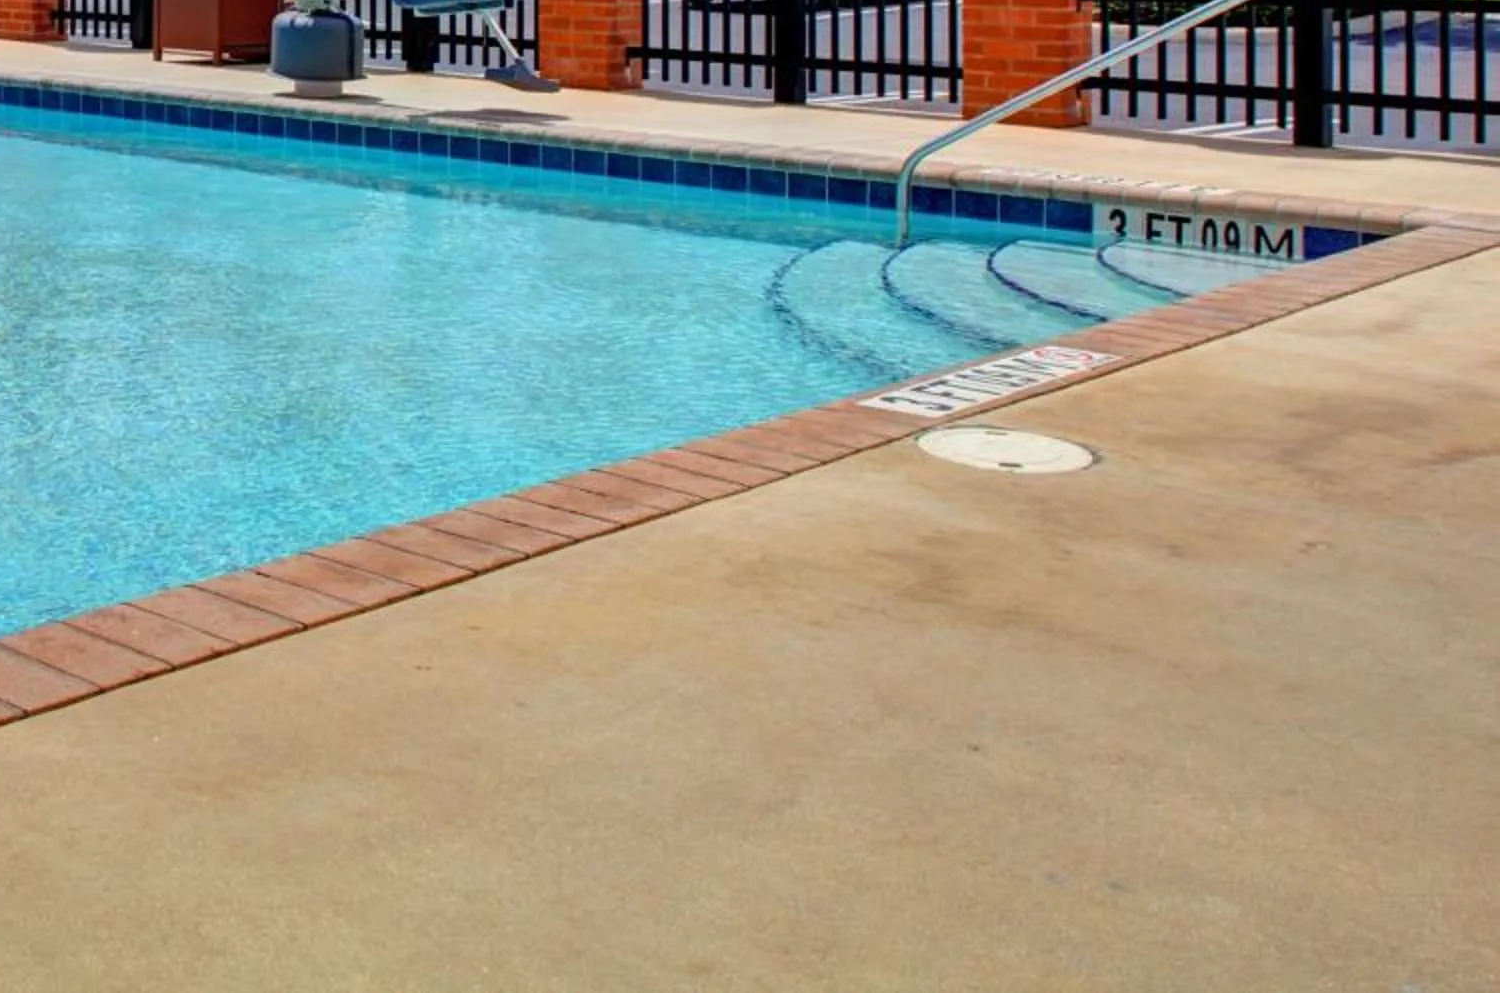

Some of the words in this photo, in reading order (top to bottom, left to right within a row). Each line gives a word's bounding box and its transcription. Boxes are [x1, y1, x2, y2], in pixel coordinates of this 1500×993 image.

[1108, 207, 1128, 238] 3
[1145, 211, 1192, 247] FT
[1253, 224, 1294, 260] M
[909, 379, 1003, 403] FT
